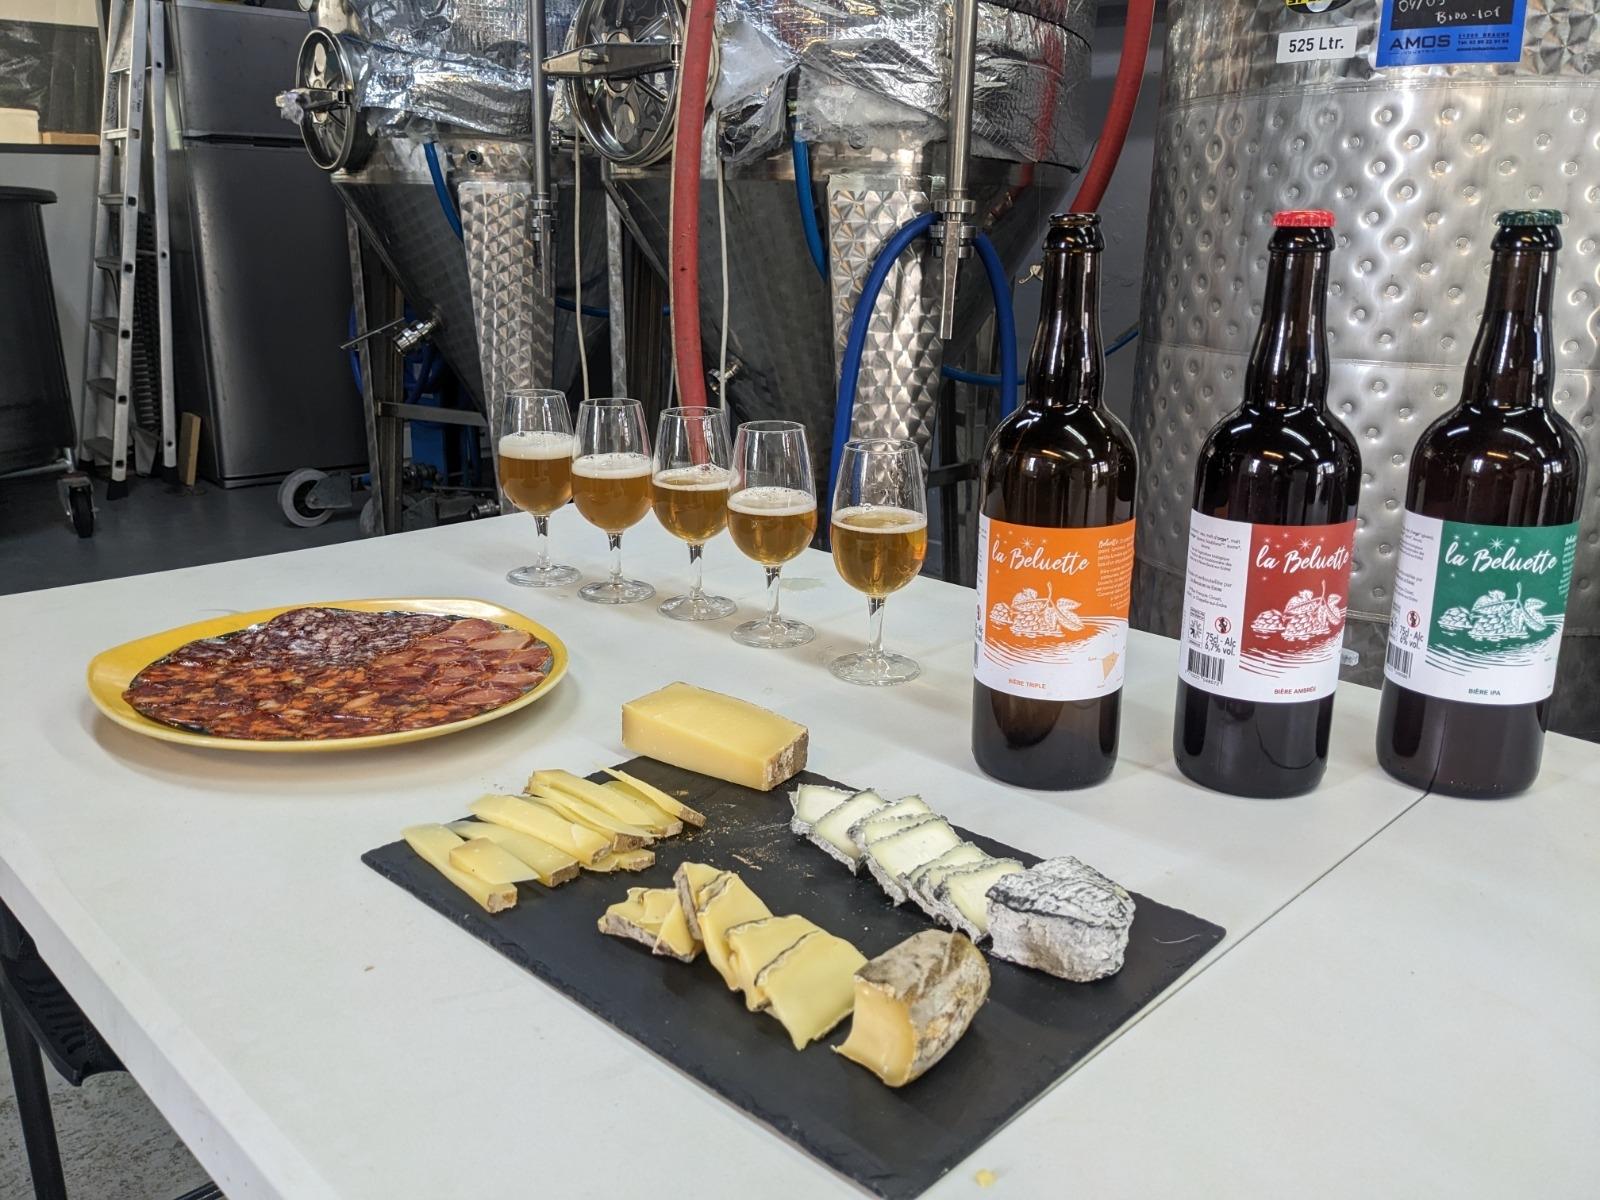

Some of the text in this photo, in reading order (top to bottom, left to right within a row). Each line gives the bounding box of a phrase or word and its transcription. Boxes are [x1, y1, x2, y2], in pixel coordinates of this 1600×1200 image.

[1288, 36, 1344, 53] 525 Ltr.
[1389, 34, 1451, 51] AMOS
[992, 540, 1089, 576] la Beluette
[1256, 544, 1280, 569] la
[1283, 544, 1349, 574] Beluette
[1445, 541, 1468, 567] la
[1472, 547, 1557, 575] Beluette
[1205, 631, 1219, 644] 75cl
[1224, 636, 1237, 647] Alc
[1409, 639, 1421, 649] vol.
[1413, 631, 1424, 642] Alc
[1204, 642, 1221, 653] 6,7%
[1222, 646, 1236, 656] vol.
[1026, 681, 1047, 690] TRIPLE
[1274, 687, 1293, 695] BIÈRE
[1468, 687, 1501, 697] BIÈRE IPA
